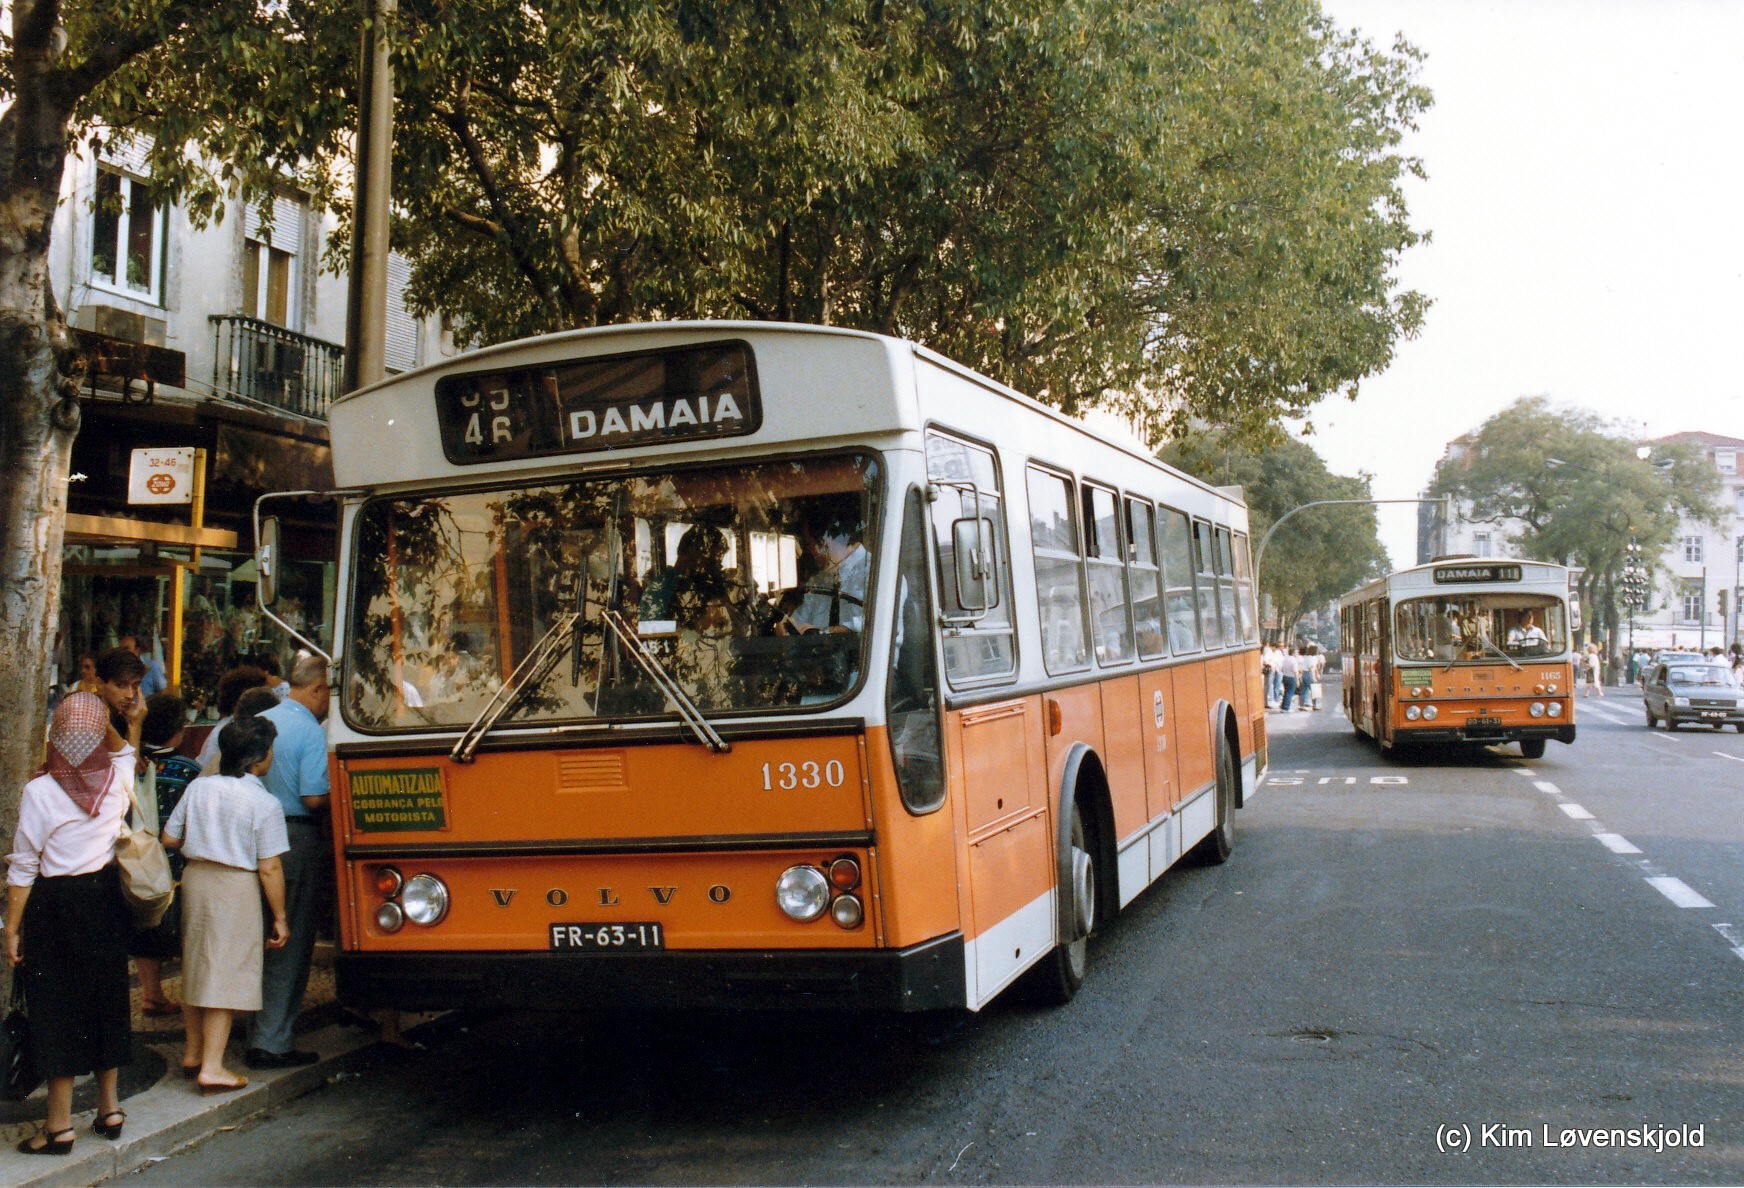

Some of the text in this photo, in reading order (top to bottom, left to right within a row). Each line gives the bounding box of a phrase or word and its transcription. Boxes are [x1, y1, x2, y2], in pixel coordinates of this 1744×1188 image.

[569, 393, 743, 440] DAMAIA
[1436, 568, 1492, 580] DAMAIA
[352, 773, 442, 795] AUTOMATIZADA
[762, 759, 845, 791] 1330
[364, 811, 436, 822] MOTORISTA
[488, 884, 732, 907] VOLVO
[552, 925, 660, 947] FR-63-11
